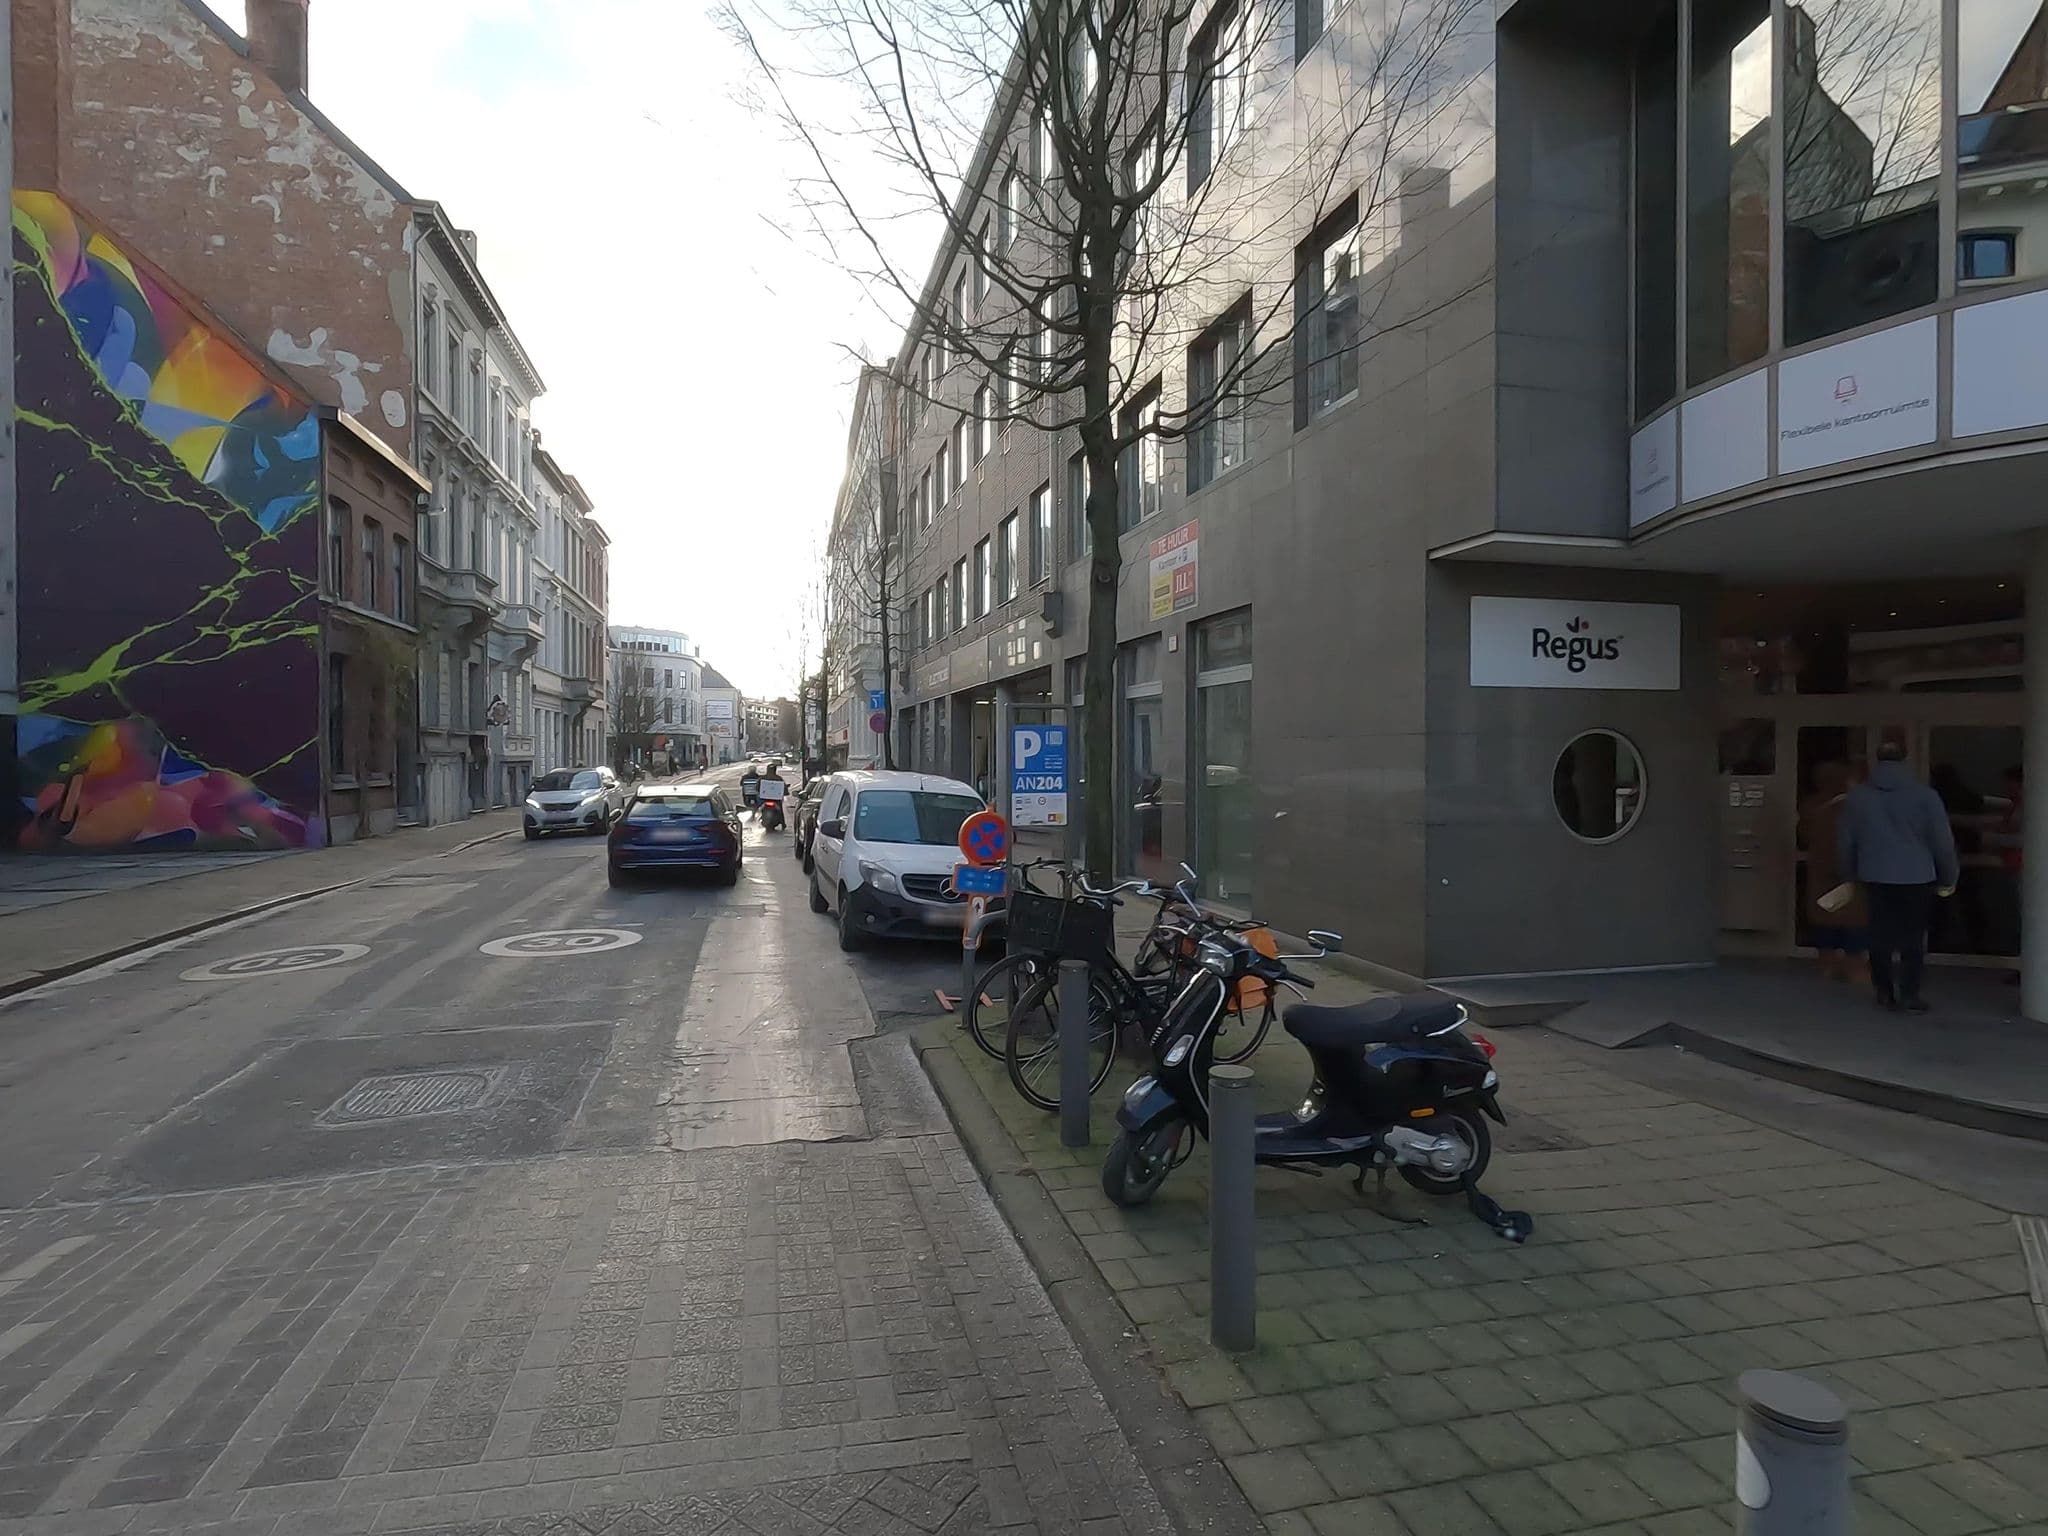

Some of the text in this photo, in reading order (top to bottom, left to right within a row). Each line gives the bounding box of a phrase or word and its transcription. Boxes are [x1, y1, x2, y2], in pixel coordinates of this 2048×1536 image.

[1158, 528, 1189, 554] TE HUUR
[1532, 628, 1619, 672] Regus
[1014, 730, 1042, 769] P
[1015, 776, 1063, 790] AN204
